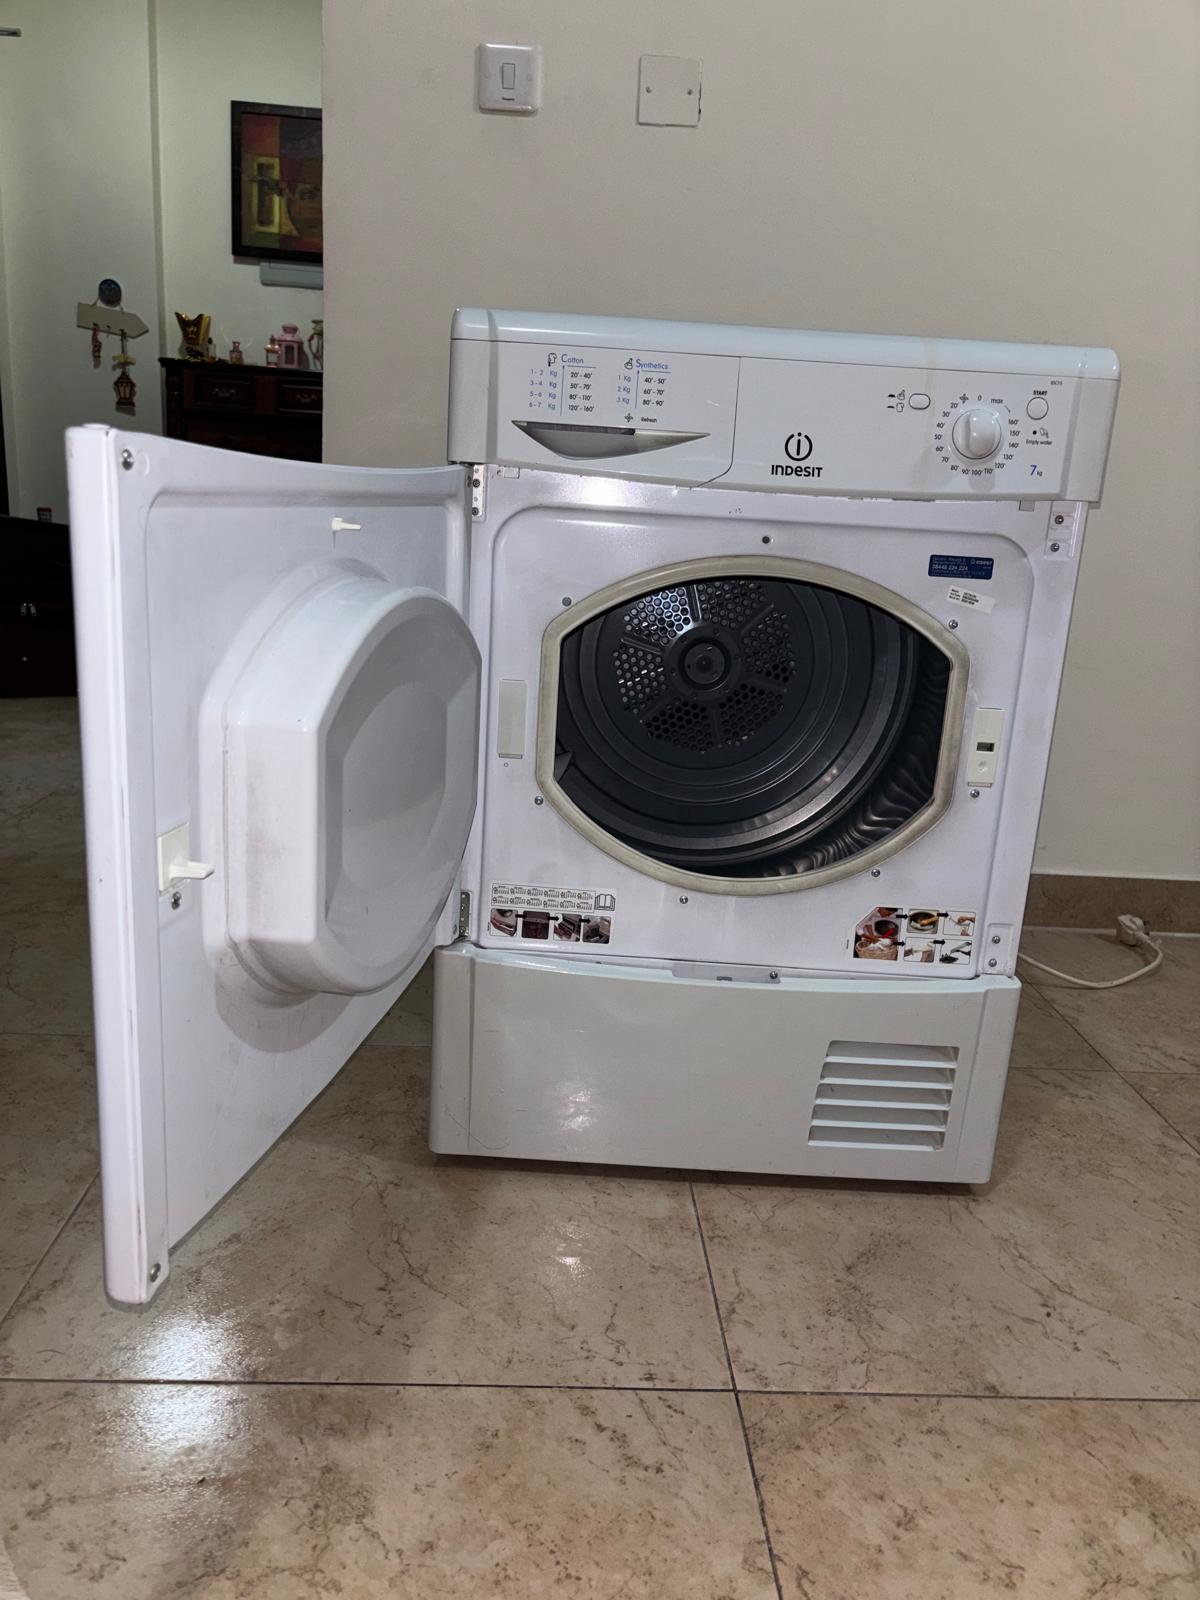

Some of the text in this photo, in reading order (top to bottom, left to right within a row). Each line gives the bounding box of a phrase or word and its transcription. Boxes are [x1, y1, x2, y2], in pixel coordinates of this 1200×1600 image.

[561, 354, 584, 364] Cotton
[636, 359, 668, 369] Synthetics
[624, 375, 631, 383] Kg
[1030, 464, 1037, 476] 7
